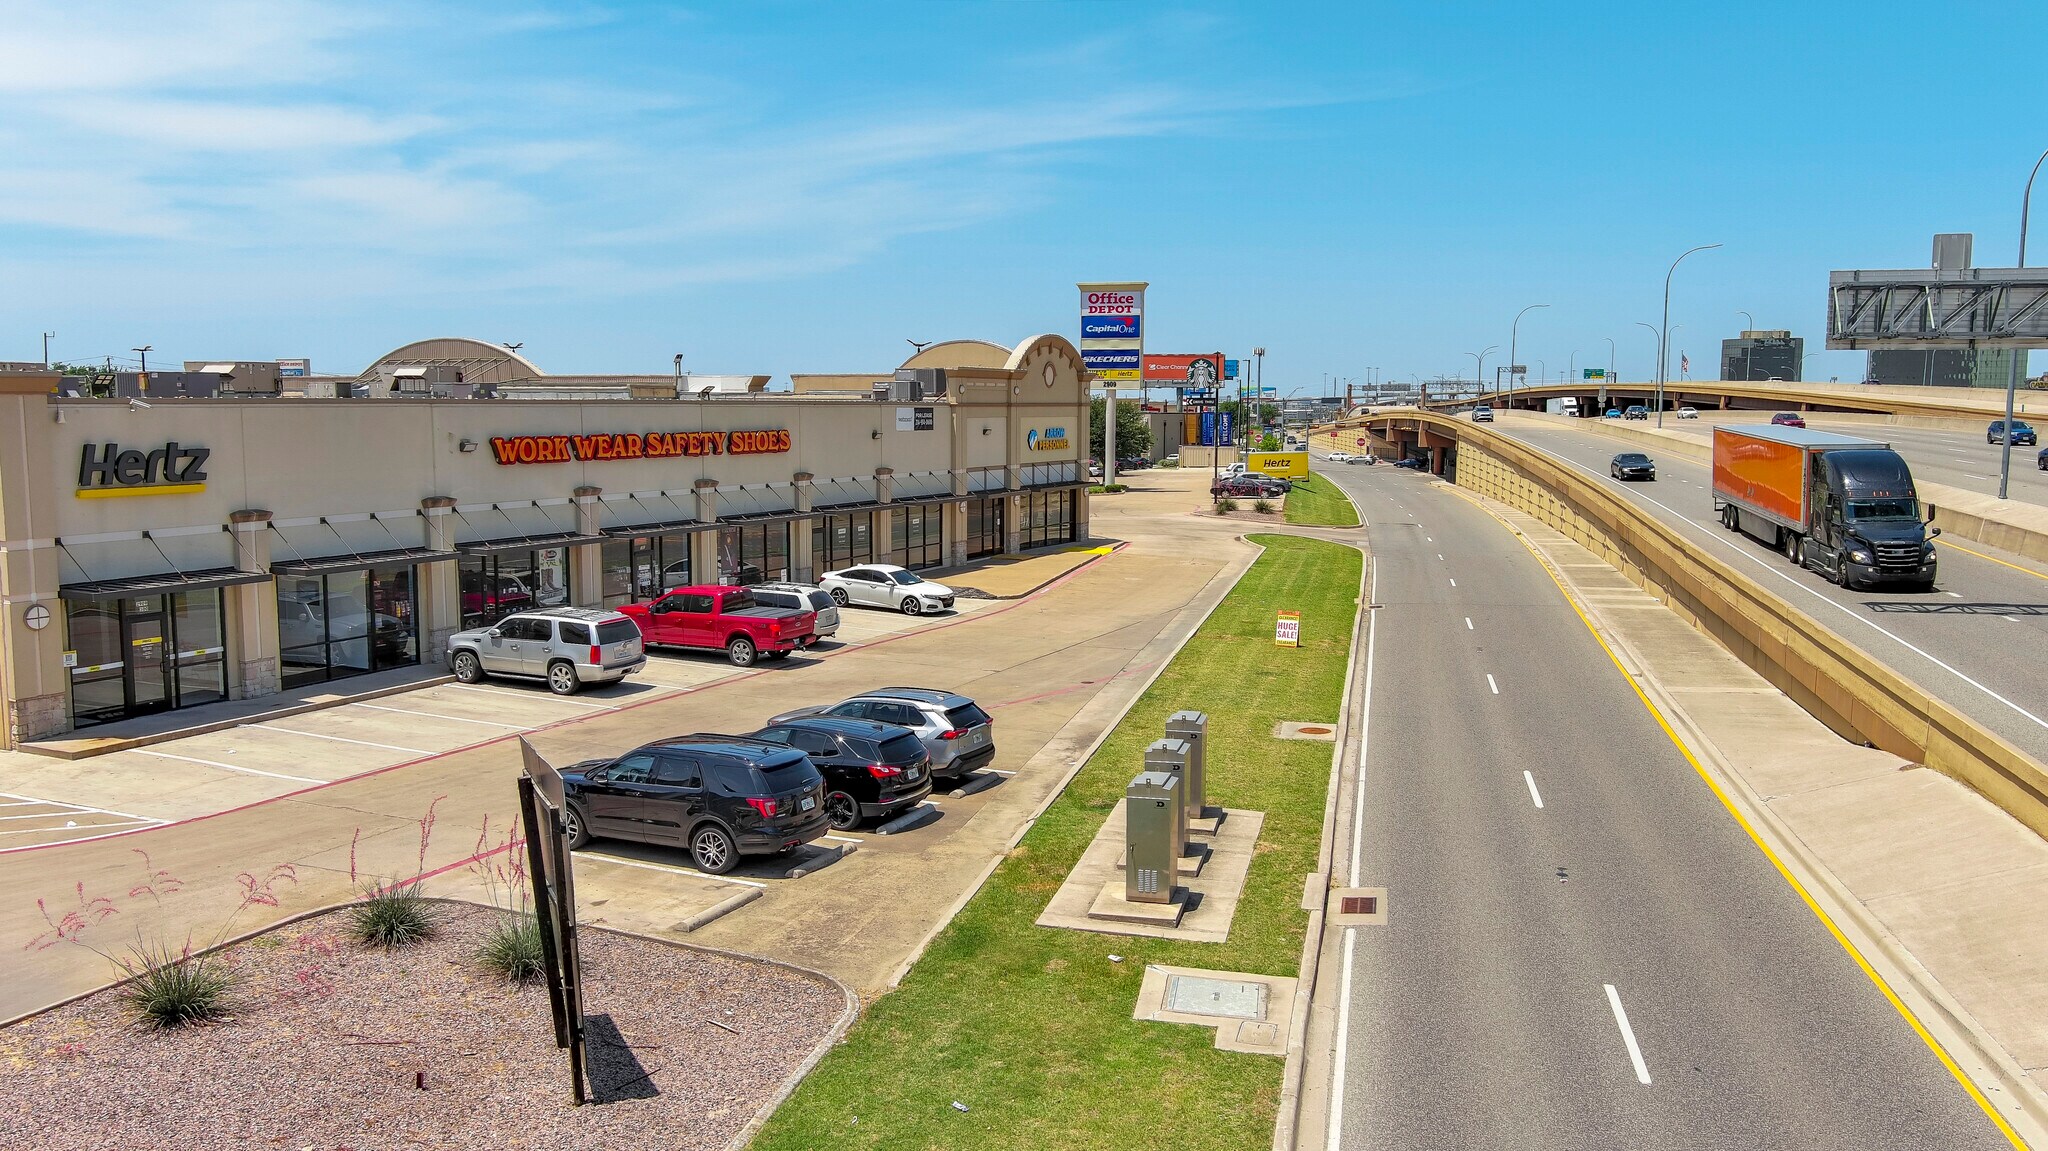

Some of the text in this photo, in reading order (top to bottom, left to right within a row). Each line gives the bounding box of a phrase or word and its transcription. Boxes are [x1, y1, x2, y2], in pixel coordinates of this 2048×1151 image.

[1088, 293, 1134, 304] Office
[1045, 428, 1065, 438] ARROW
[492, 430, 791, 465] WORK WEAR SAFETY SHOES
[79, 442, 210, 486] Hertz
[1264, 459, 1291, 467] Hertz
[1277, 622, 1297, 630] HUGE
[1277, 630, 1297, 639] SALE!
